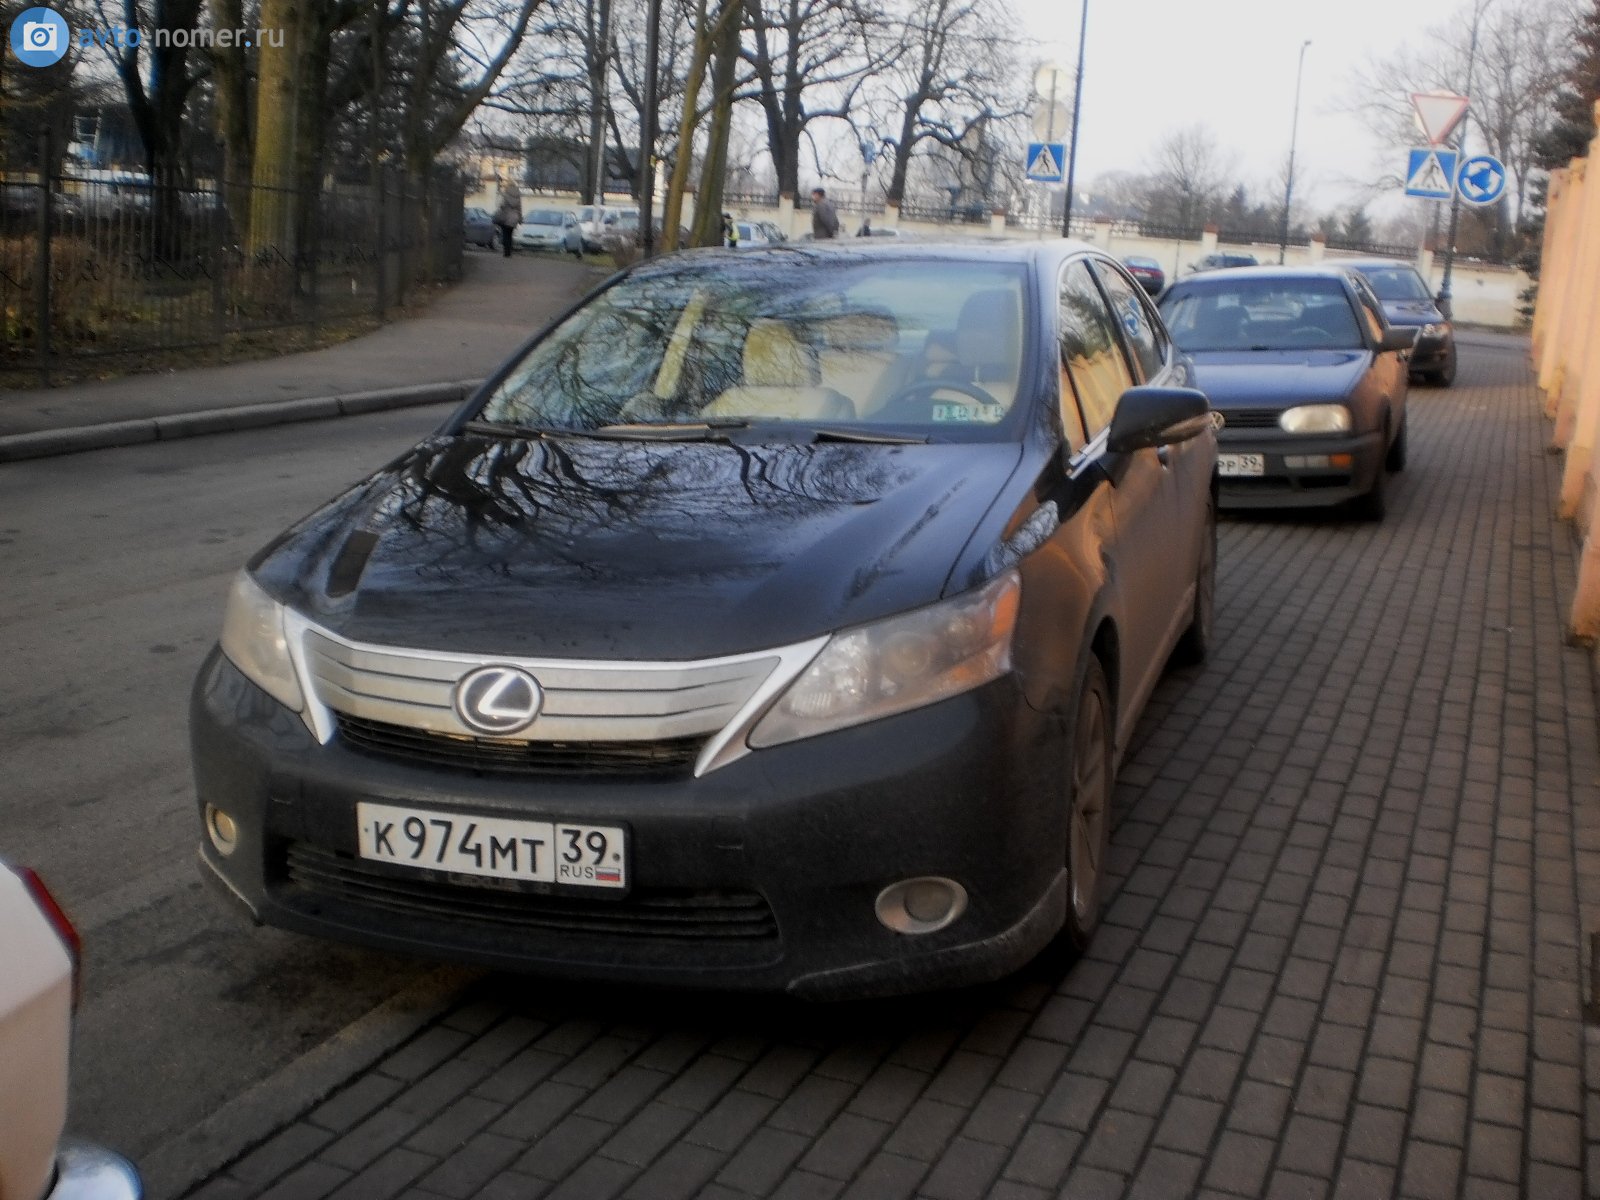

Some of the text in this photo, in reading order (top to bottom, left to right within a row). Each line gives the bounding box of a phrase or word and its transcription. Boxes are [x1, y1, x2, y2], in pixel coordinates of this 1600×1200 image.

[373, 816, 608, 874] К974МТ 39
[559, 864, 594, 879] RUS
